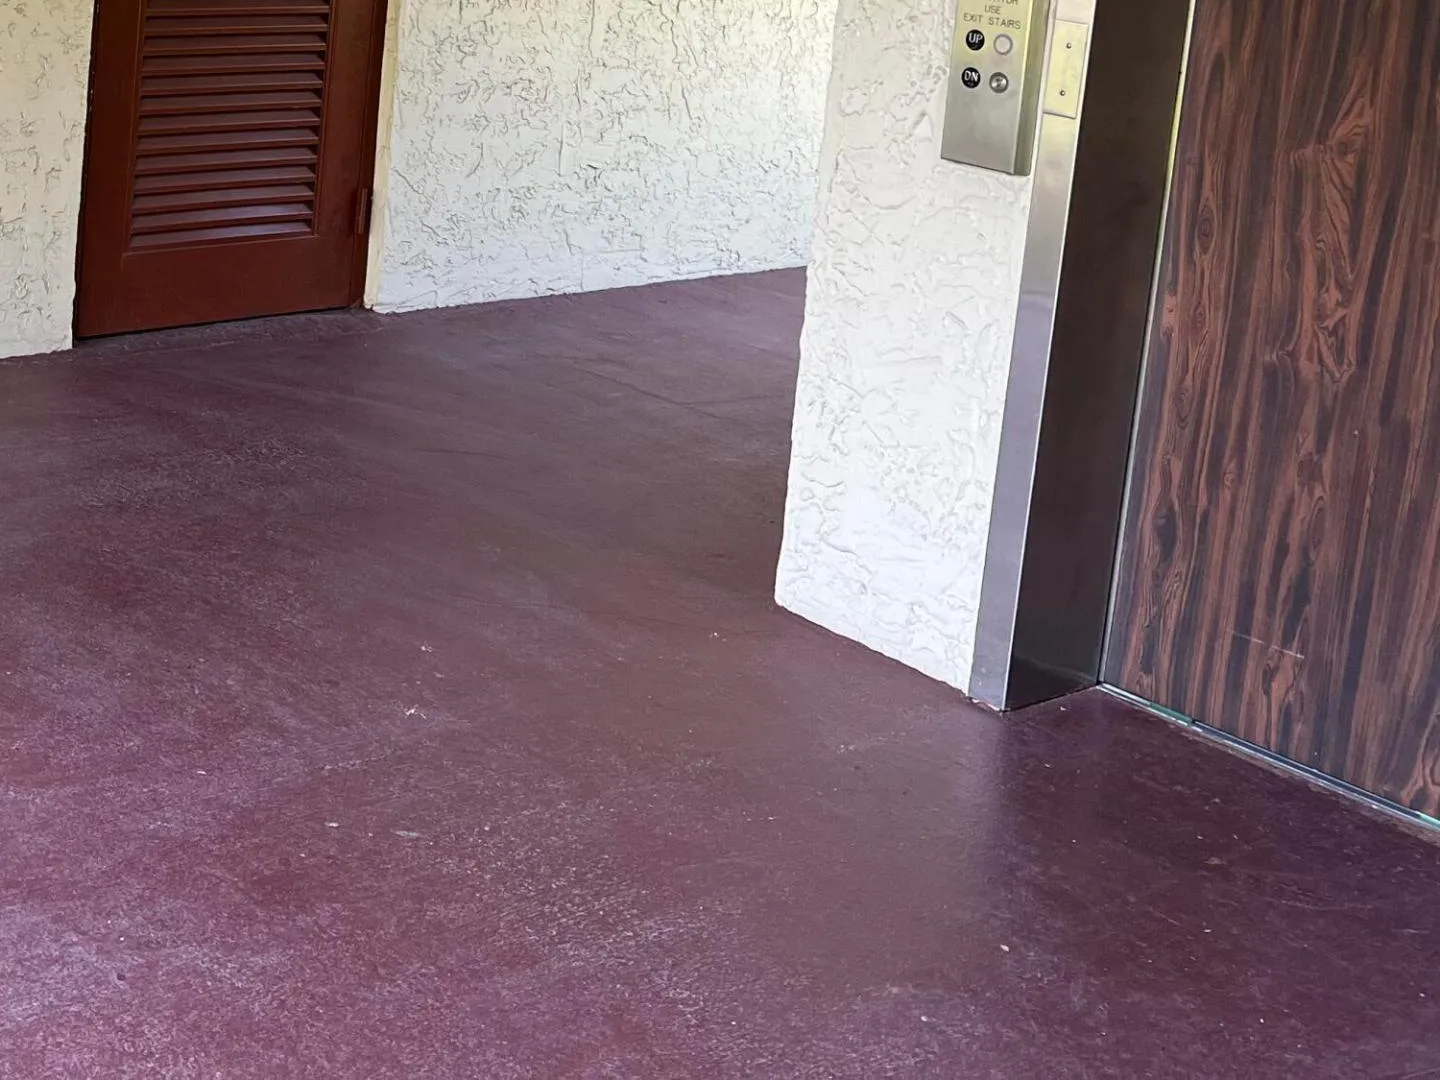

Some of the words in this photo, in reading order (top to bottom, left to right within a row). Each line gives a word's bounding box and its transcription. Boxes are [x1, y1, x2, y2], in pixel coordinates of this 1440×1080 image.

[984, 5, 1002, 15] USE
[963, 12, 983, 23] EXIT
[988, 17, 1022, 30] STAIRS
[968, 32, 983, 44] UP
[964, 70, 979, 82] DN
